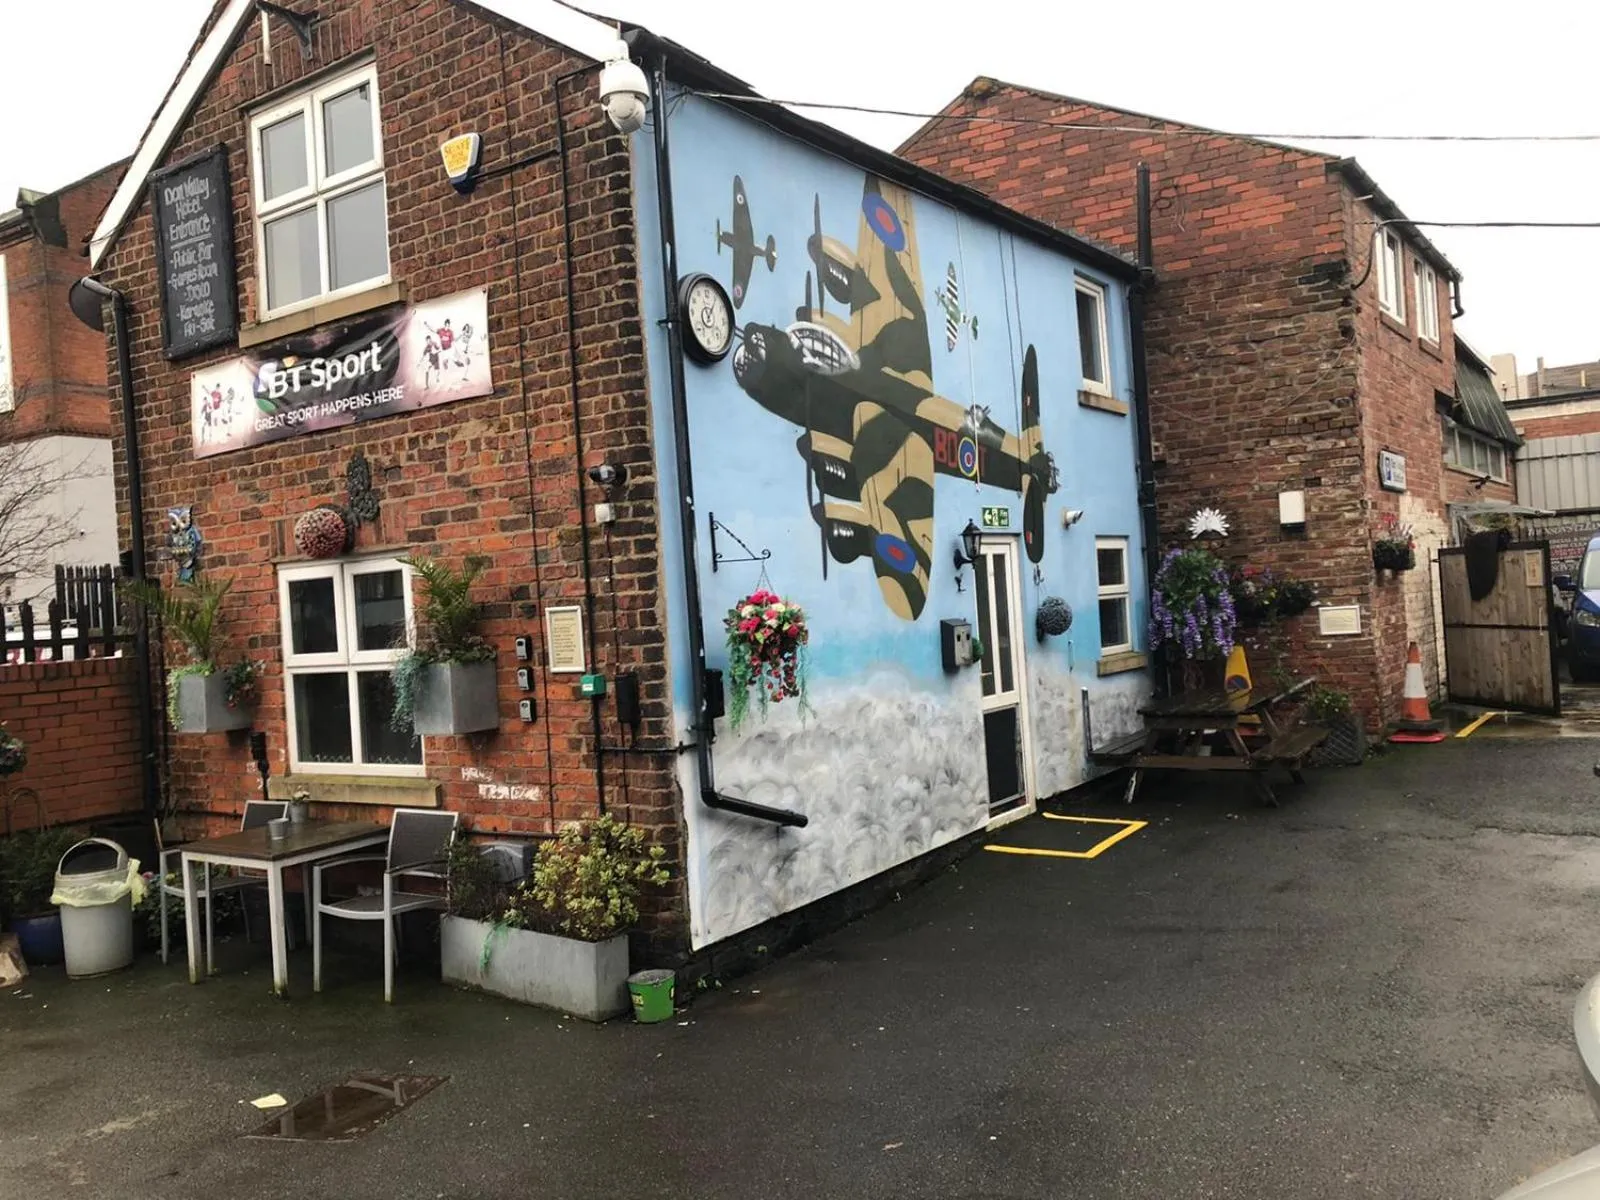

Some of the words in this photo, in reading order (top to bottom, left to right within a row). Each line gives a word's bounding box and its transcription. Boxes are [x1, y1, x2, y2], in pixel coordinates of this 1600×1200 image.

[164, 183, 185, 206] Don
[183, 175, 210, 200] Valley
[176, 195, 204, 221] Hotel
[169, 213, 211, 242] Entrance
[268, 365, 307, 399] BT
[310, 341, 382, 391] Sport
[255, 413, 286, 432] GREAT
[287, 405, 319, 425] SPORT
[320, 392, 372, 417] HAPPENS
[372, 385, 405, 405] HERE
